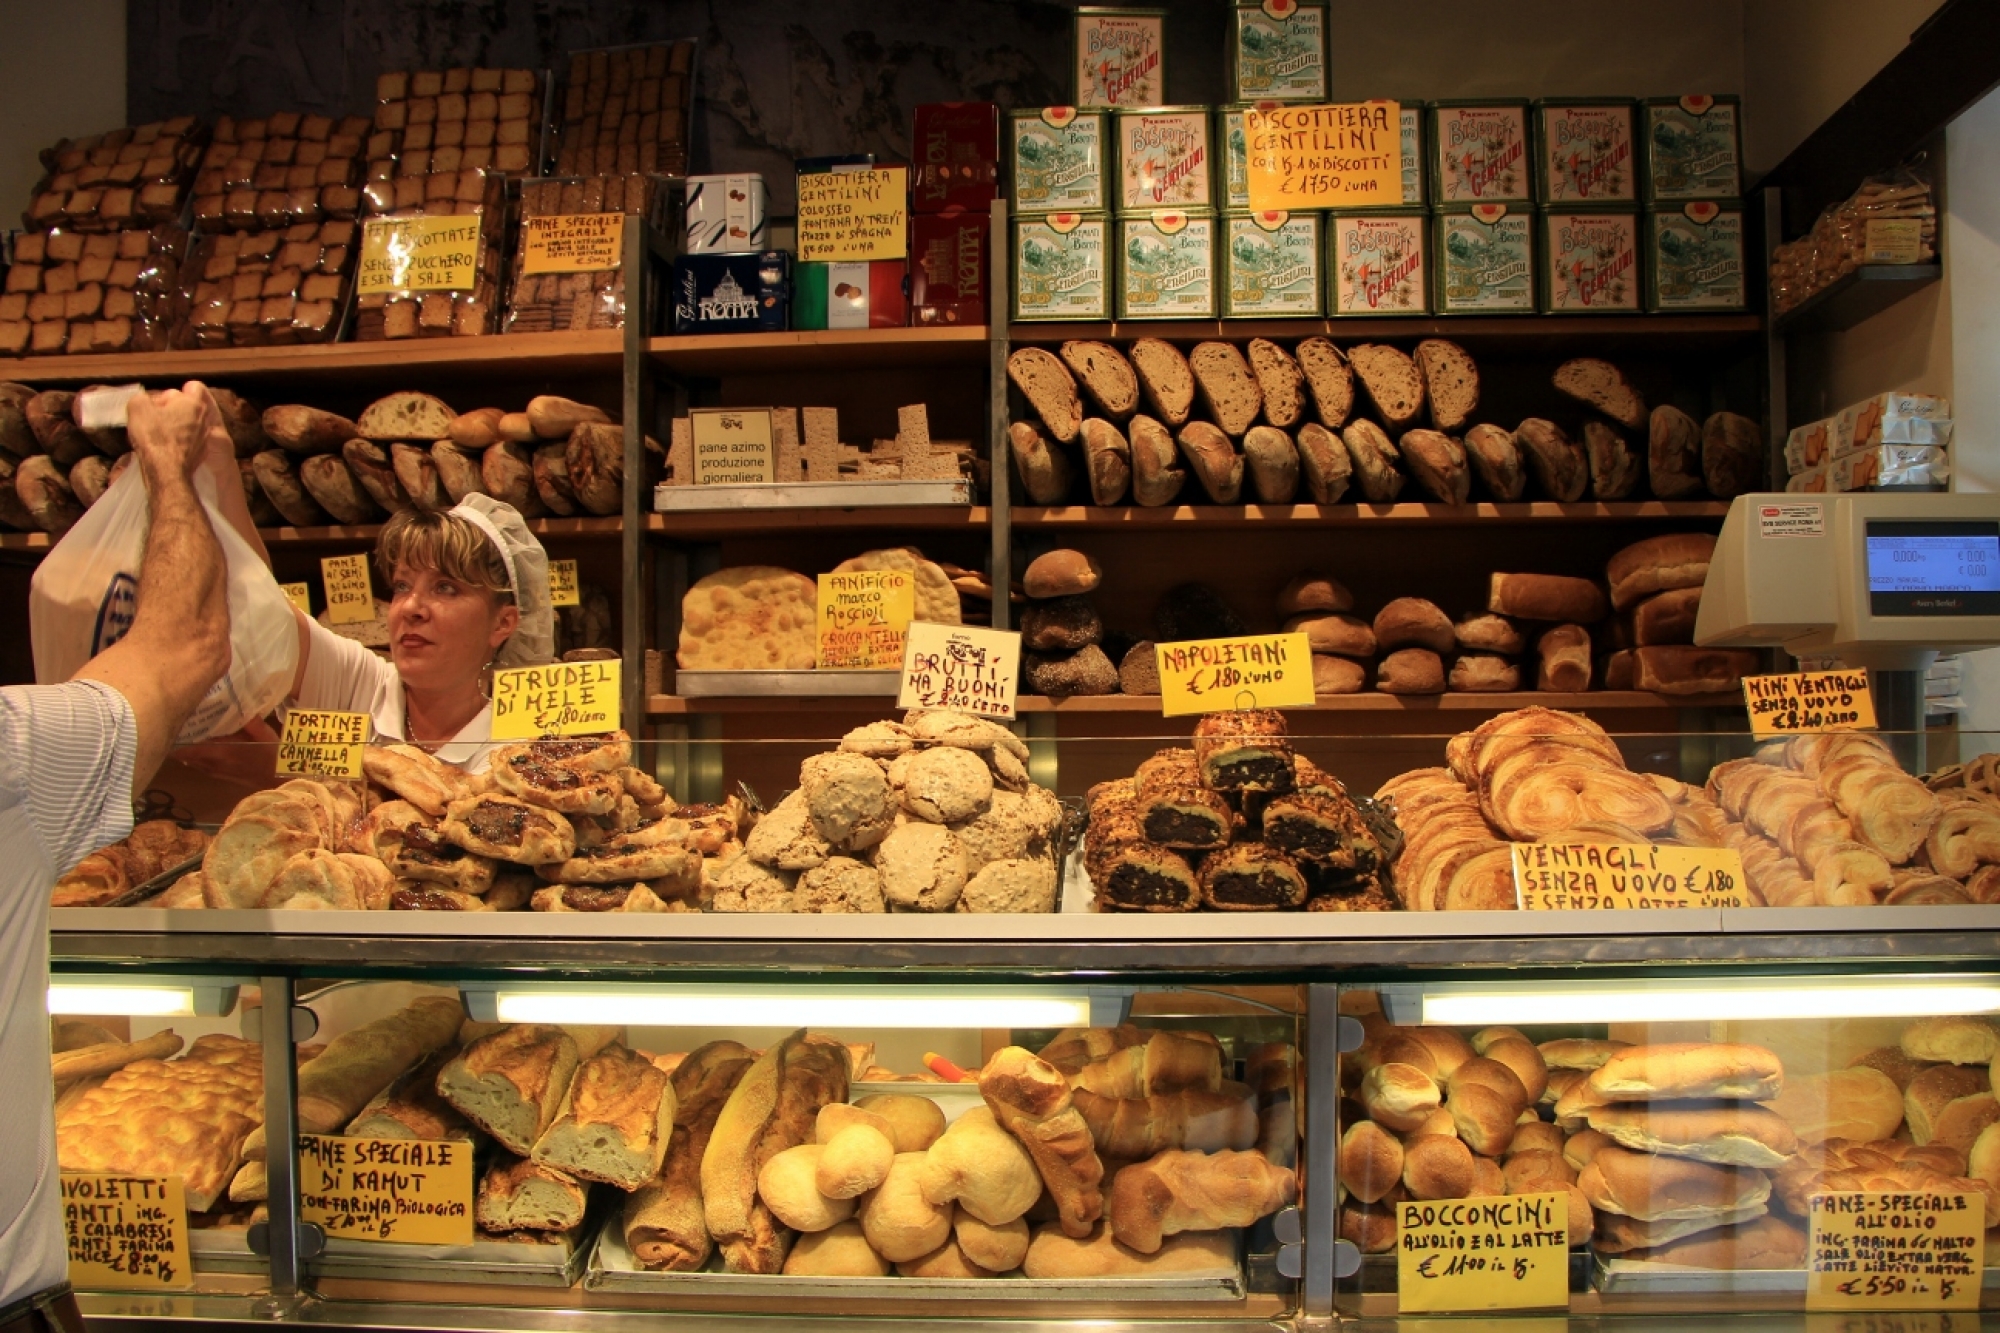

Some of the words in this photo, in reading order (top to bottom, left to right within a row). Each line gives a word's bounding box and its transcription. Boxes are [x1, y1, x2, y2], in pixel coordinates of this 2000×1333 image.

[1107, 50, 1158, 103] GENTILINI
[1153, 146, 1203, 202] GENTILINI
[1471, 139, 1522, 197] GENTILINI
[1578, 139, 1629, 197] GENTILINI
[799, 204, 852, 217] COLOSSEO
[529, 218, 559, 230] PANE
[565, 216, 621, 227] SPECIALE
[541, 228, 606, 239] INTEGRALE
[849, 227, 892, 240] SPAGNA
[418, 272, 453, 285] SALE
[1366, 251, 1419, 308] GENTILINI
[1580, 249, 1633, 305] GENTILINI
[698, 300, 760, 321] ROMA
[699, 443, 728, 455] pane
[731, 441, 766, 453] azimo
[701, 456, 765, 471] produzione
[703, 472, 763, 485] giornaliera
[868, 643, 899, 654] EXTRA
[1163, 638, 1287, 673] NAPOLETANI
[498, 664, 611, 694] STRUDEL
[909, 674, 931, 693] MA
[943, 675, 1009, 699] BUONI
[1748, 677, 1788, 698] MINI
[1793, 671, 1867, 696] VENTAGLI
[525, 686, 596, 712] MELE
[1752, 696, 1799, 715] SENZA
[1804, 693, 1853, 709] UOVO
[289, 712, 363, 732] TORTINE
[1519, 844, 1659, 872] VENTAGLI
[1524, 870, 1599, 894] SENZA
[1612, 873, 1677, 893] UOVO
[299, 1136, 346, 1168] PANE
[353, 1141, 453, 1166] SPECIALE
[352, 1170, 427, 1200] KAMUT
[395, 1198, 466, 1217] BIOLOGICA
[1403, 1196, 1555, 1229] BOCCONCINI
[84, 1218, 174, 1242] CALABRESI
[1855, 1211, 1936, 1230] ALL'OLIO
[119, 1239, 175, 1253] FARINA
[1511, 1230, 1566, 1249] LATTE
[1852, 1235, 1907, 1249] FARINA
[1933, 1236, 1976, 1250] MALTO
[1814, 1249, 1850, 1262] SALE
[1888, 1251, 1933, 1263] EXTRA
[1814, 1261, 1857, 1273] LATTE
[1863, 1261, 1919, 1273] LIEVITO
